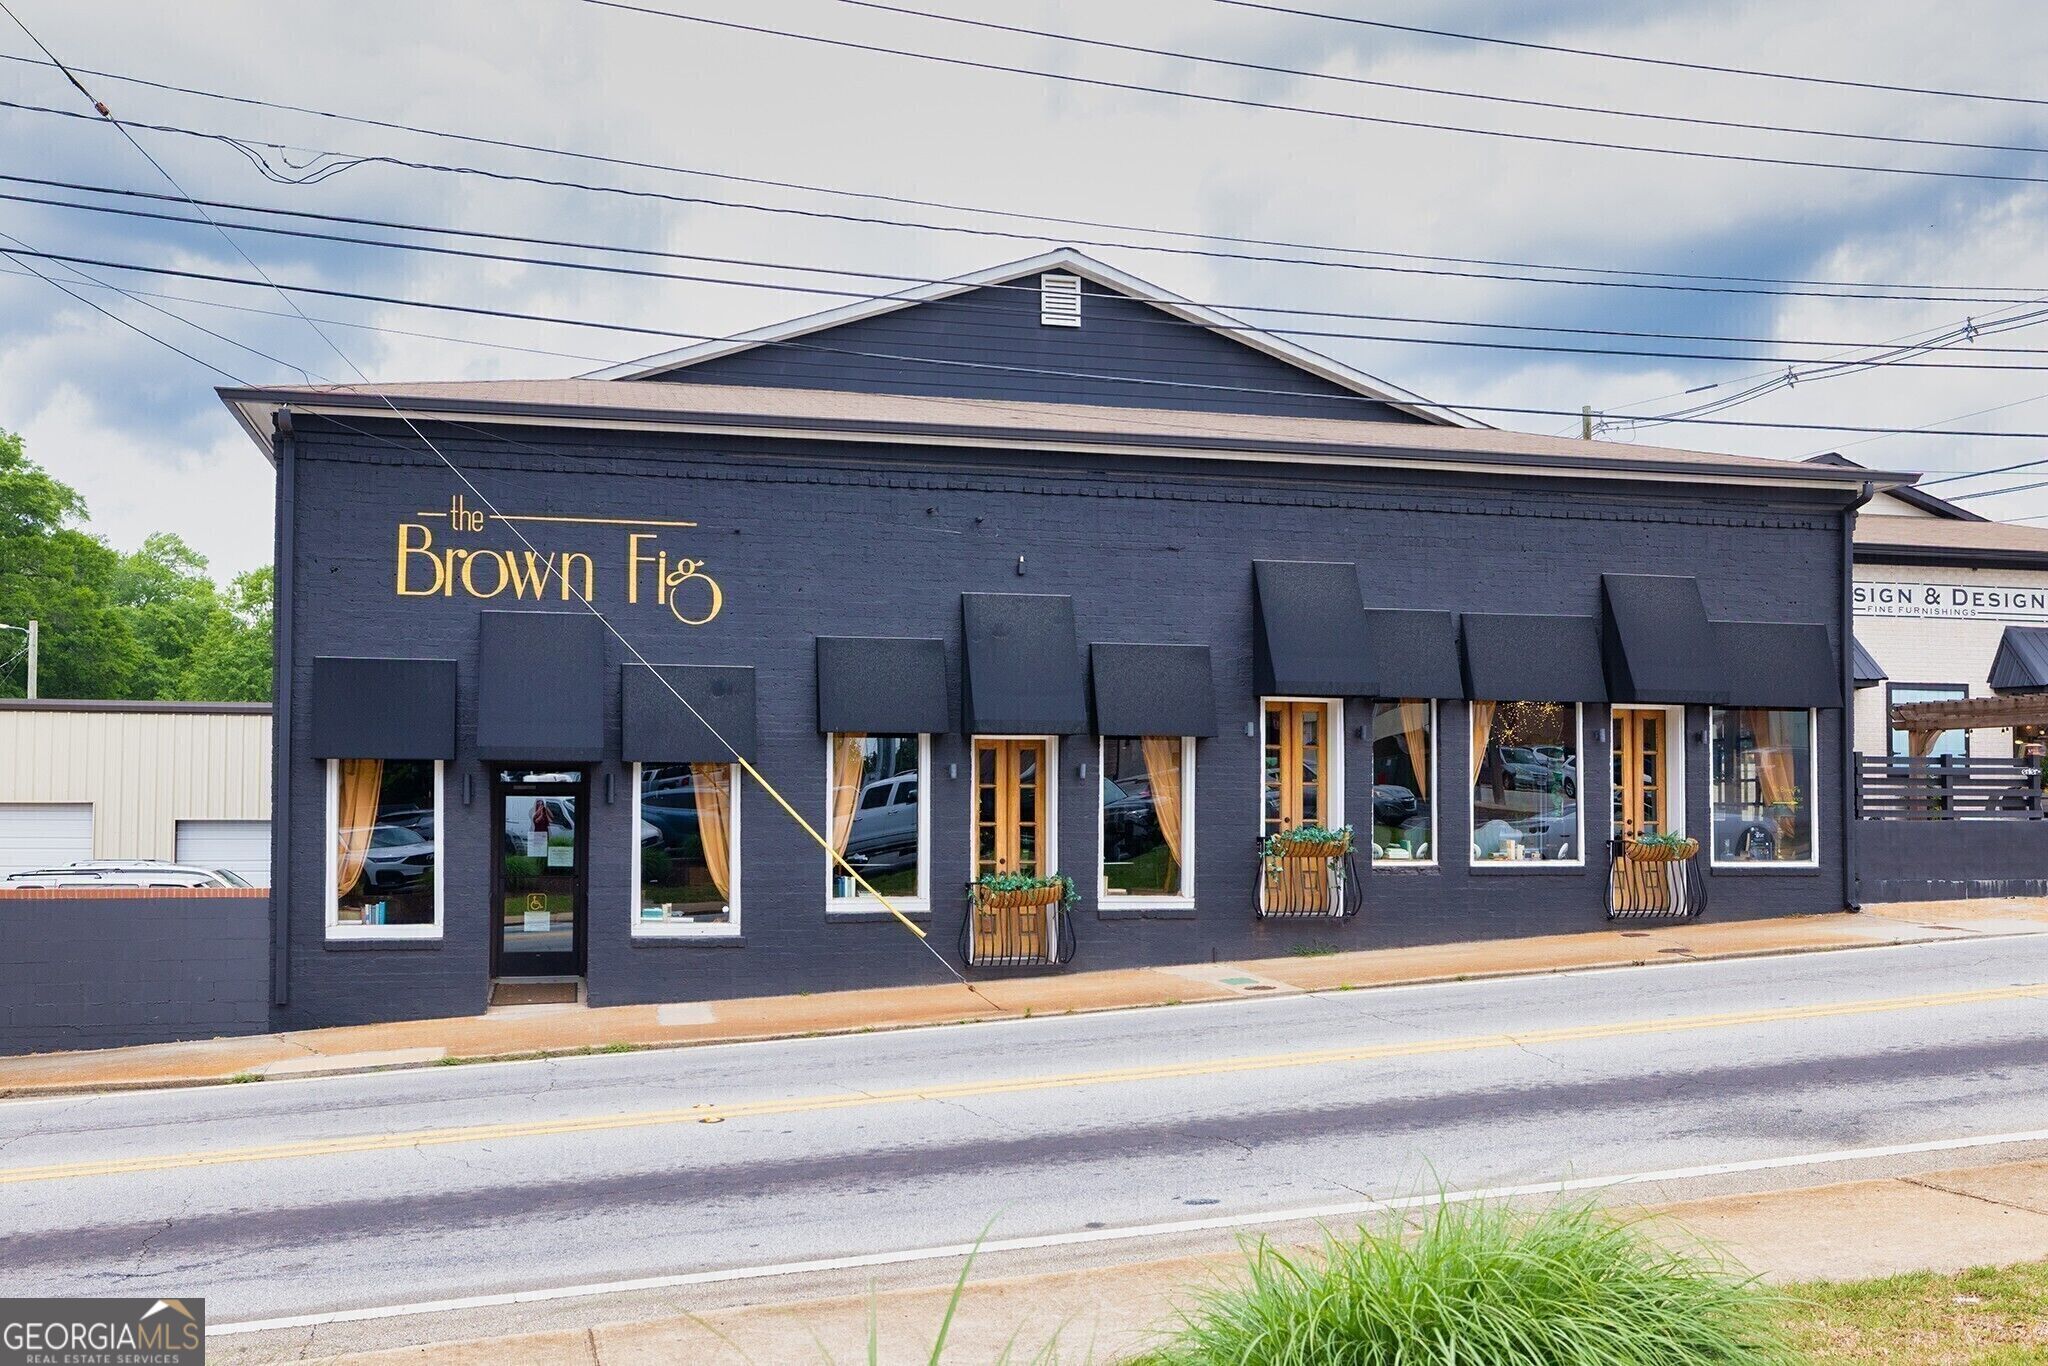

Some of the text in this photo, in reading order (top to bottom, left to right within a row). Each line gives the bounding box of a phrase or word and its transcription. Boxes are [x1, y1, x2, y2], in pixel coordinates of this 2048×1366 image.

[450, 494, 484, 532] the
[397, 523, 723, 625] Brown Fig
[1867, 605, 1976, 617] FINE FURNISHINGS
[1925, 587, 1941, 606] &
[1952, 588, 2045, 609] DESIGN
